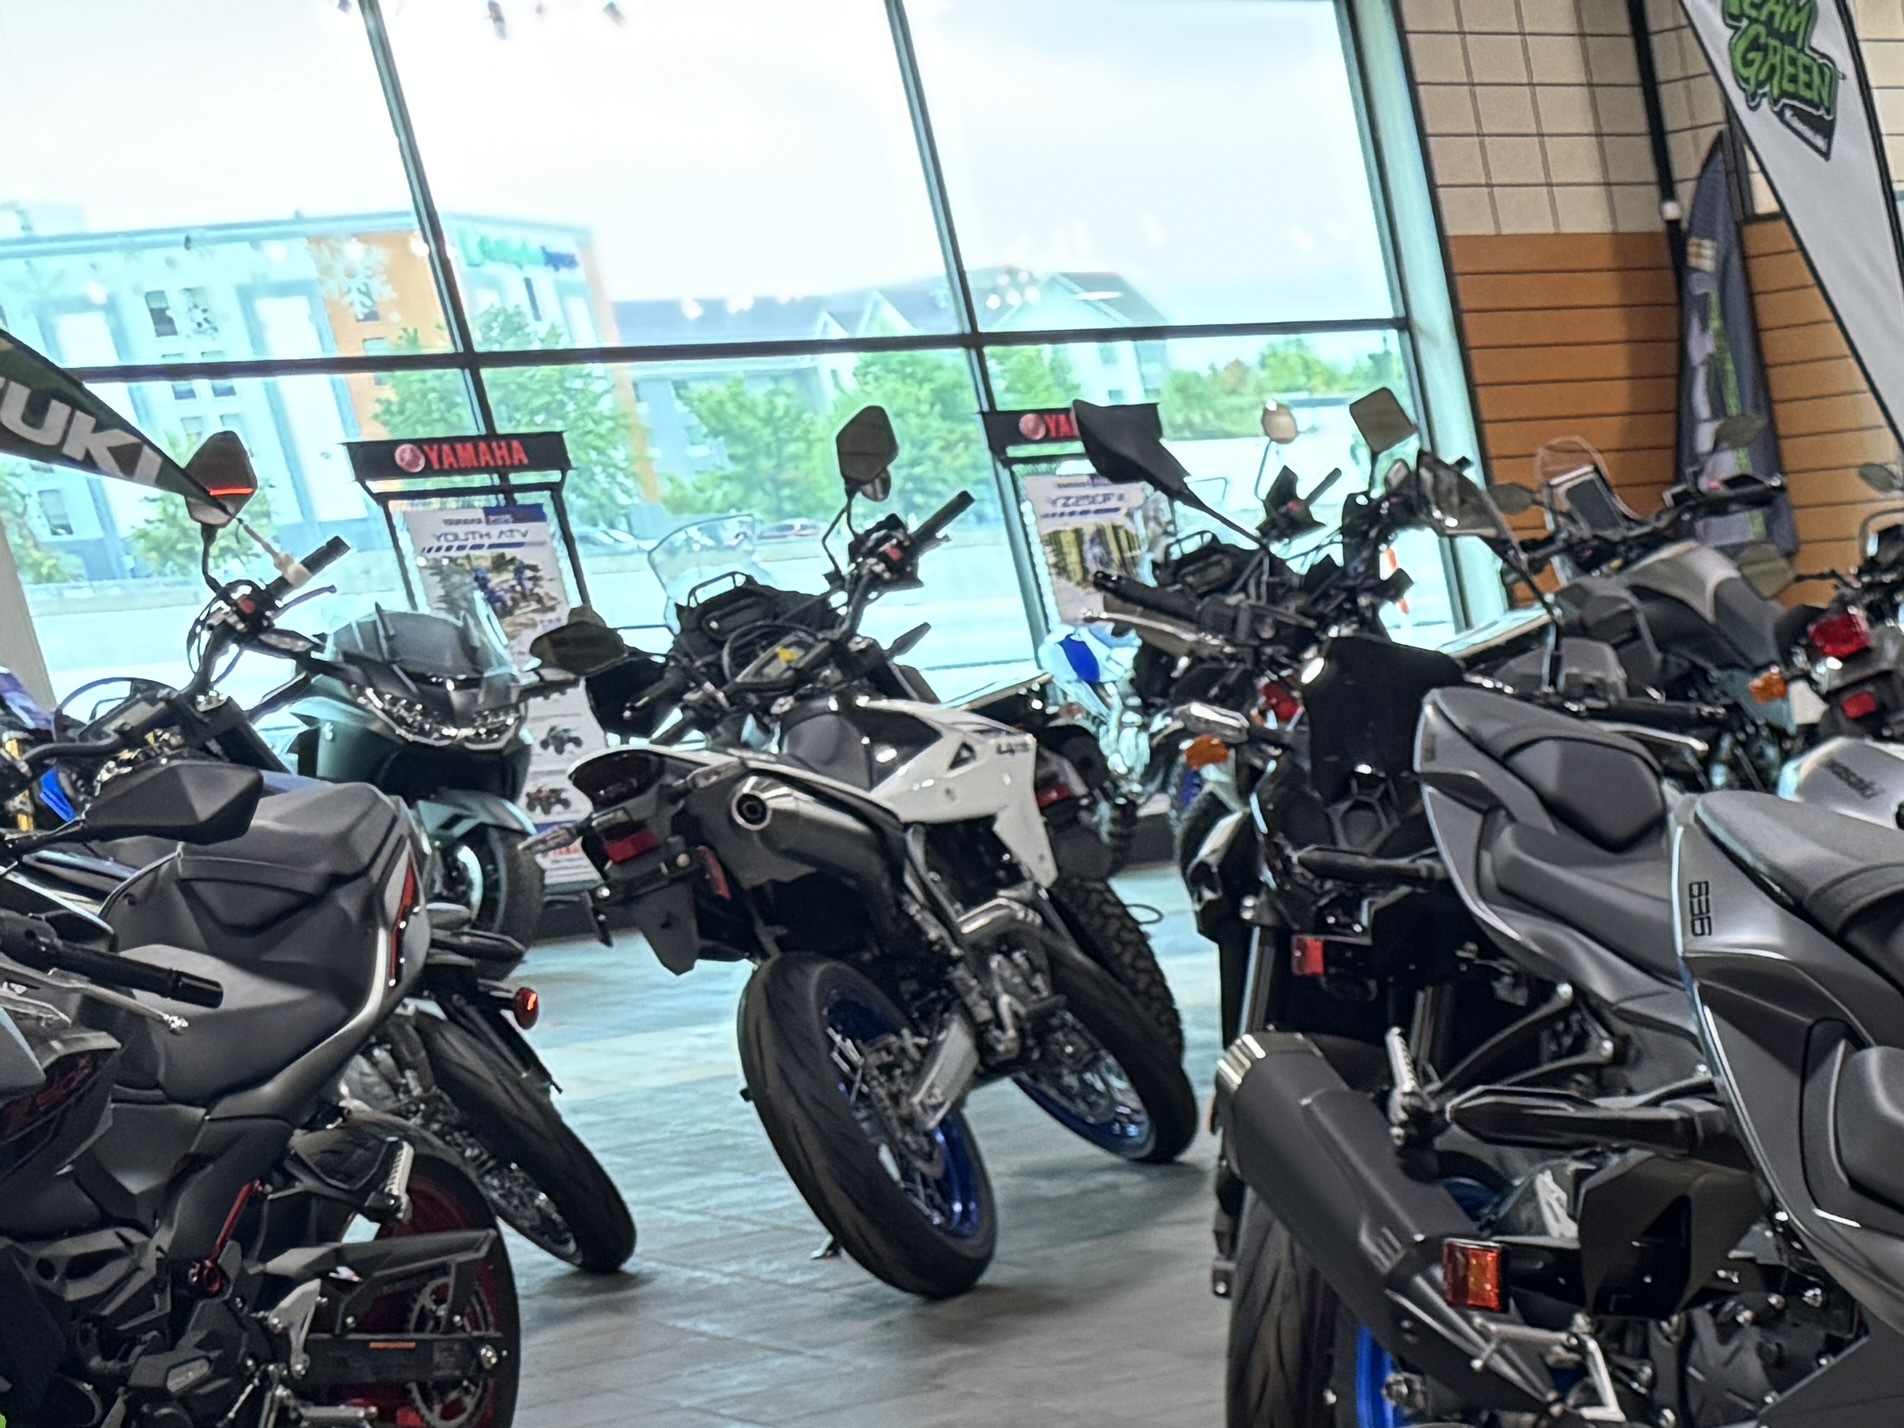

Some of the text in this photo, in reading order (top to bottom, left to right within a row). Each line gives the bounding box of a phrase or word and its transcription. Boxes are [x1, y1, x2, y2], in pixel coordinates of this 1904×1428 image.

[1724, 0, 1812, 49] EAM
[1734, 23, 1833, 106] GREEN
[0, 376, 163, 485] UKI
[424, 440, 529, 470] YAMAHA
[434, 528, 530, 544] YOUTH ATV
[1688, 880, 1713, 937] 636
